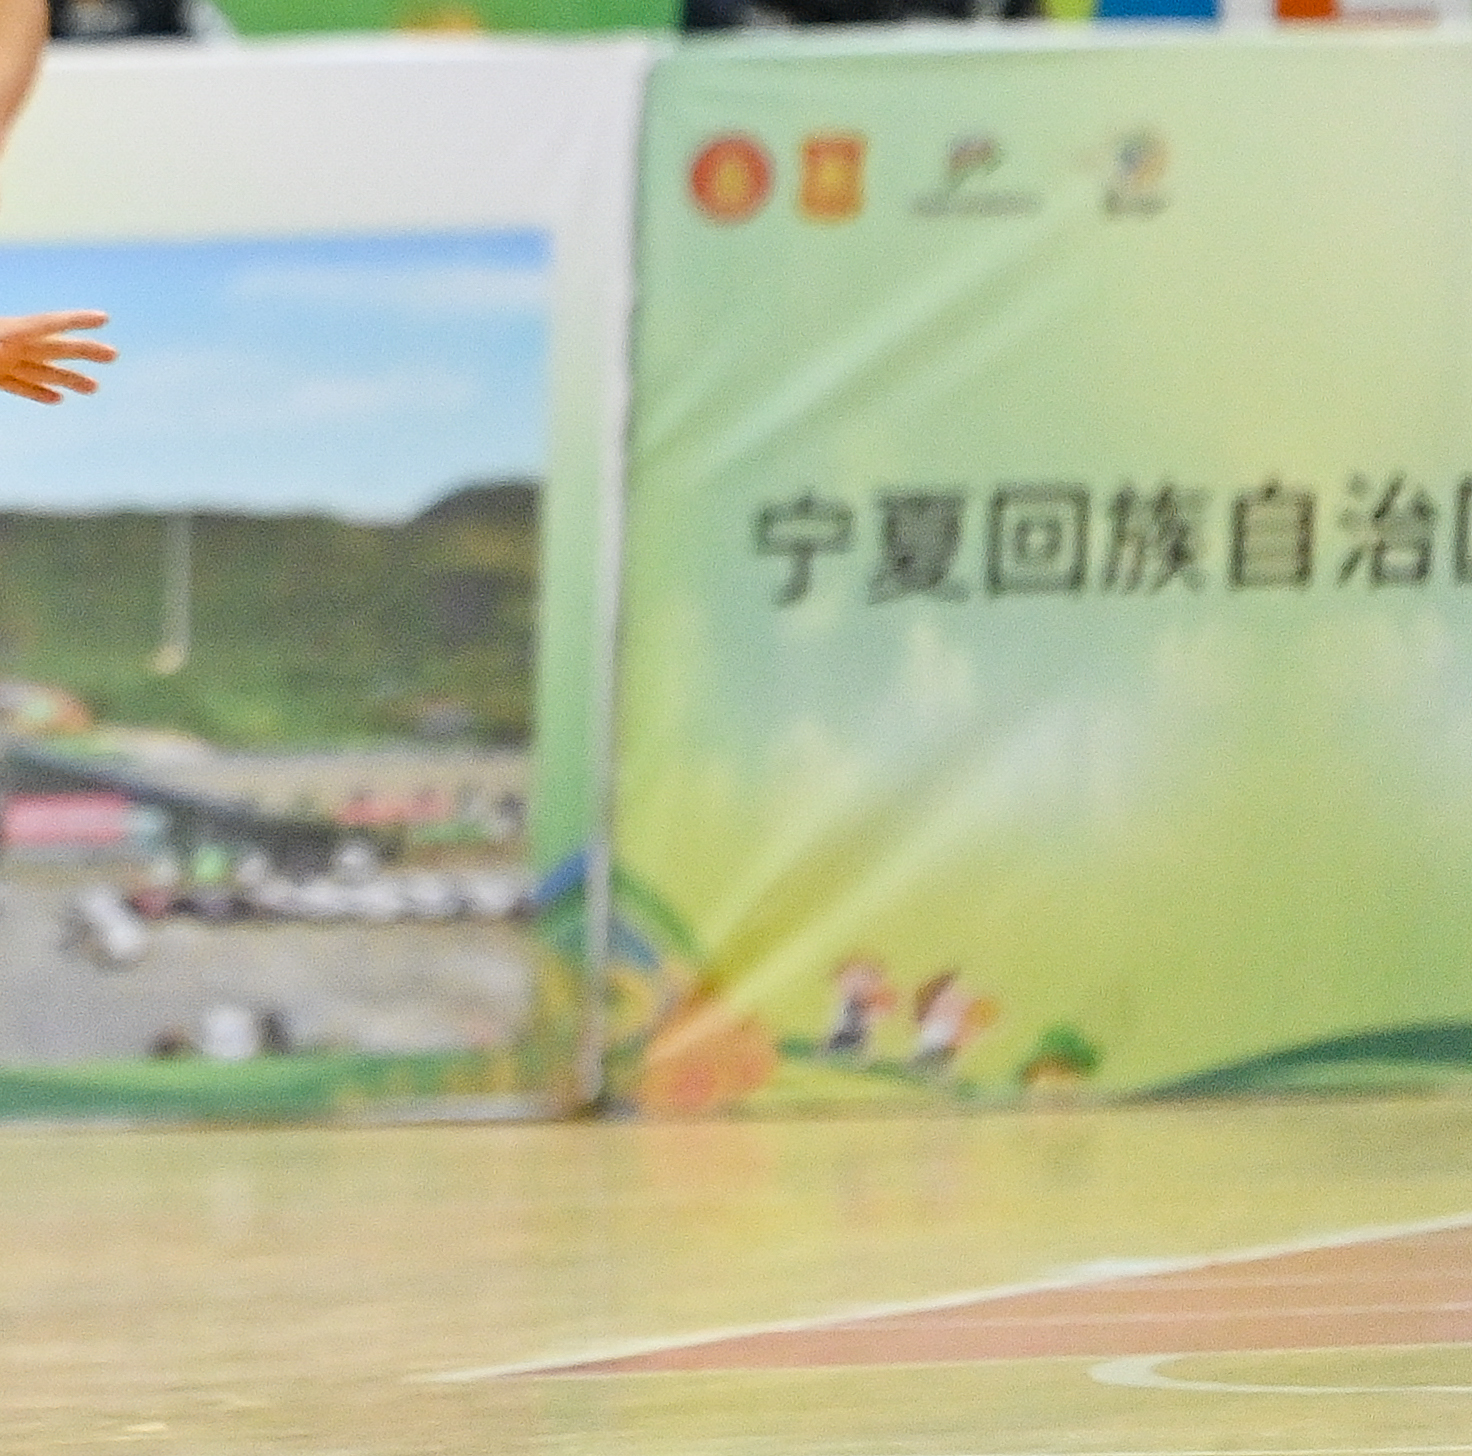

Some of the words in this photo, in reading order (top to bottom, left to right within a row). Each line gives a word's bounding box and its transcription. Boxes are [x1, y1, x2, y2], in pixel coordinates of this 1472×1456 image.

[750, 468, 1472, 608] 宁夏回族自治
